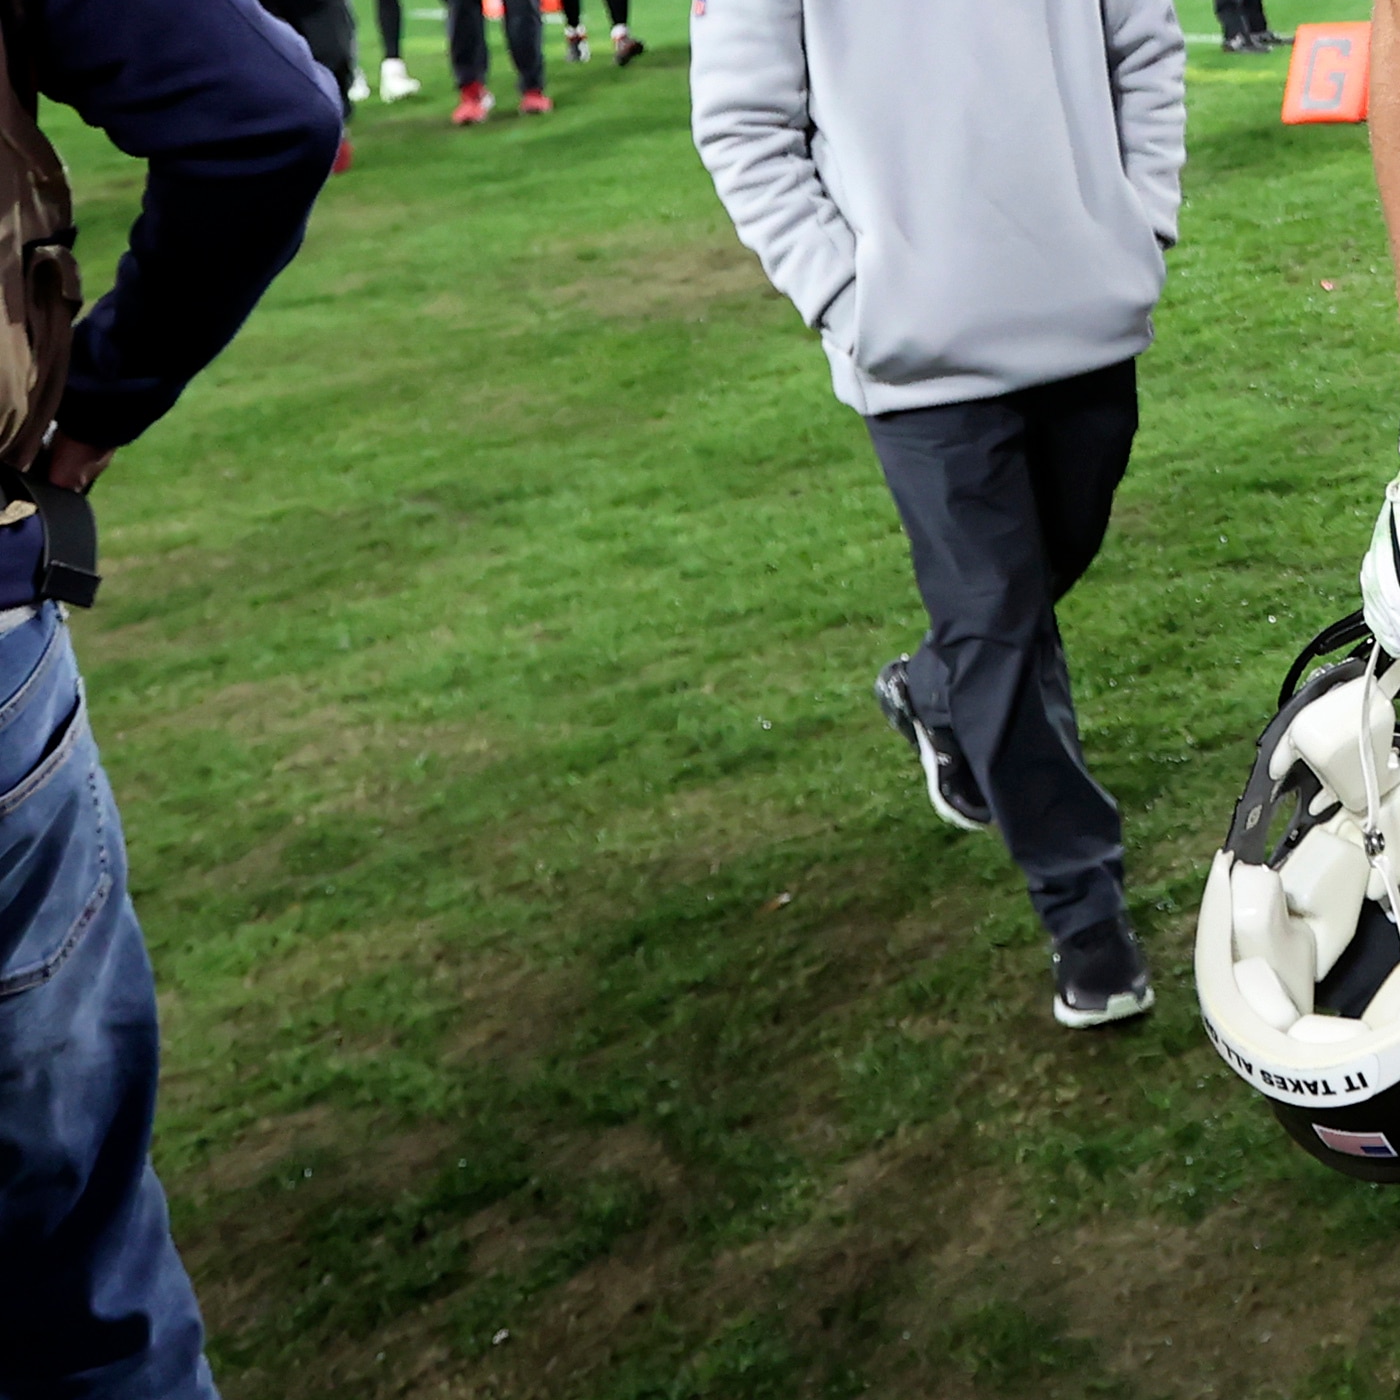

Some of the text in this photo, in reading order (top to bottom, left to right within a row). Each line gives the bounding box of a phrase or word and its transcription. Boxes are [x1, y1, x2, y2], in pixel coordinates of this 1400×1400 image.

[1302, 38, 1352, 111] G
[1220, 1038, 1253, 1076] ALL
[1259, 1068, 1338, 1097] TAKES
[1345, 1071, 1370, 1094] IT
